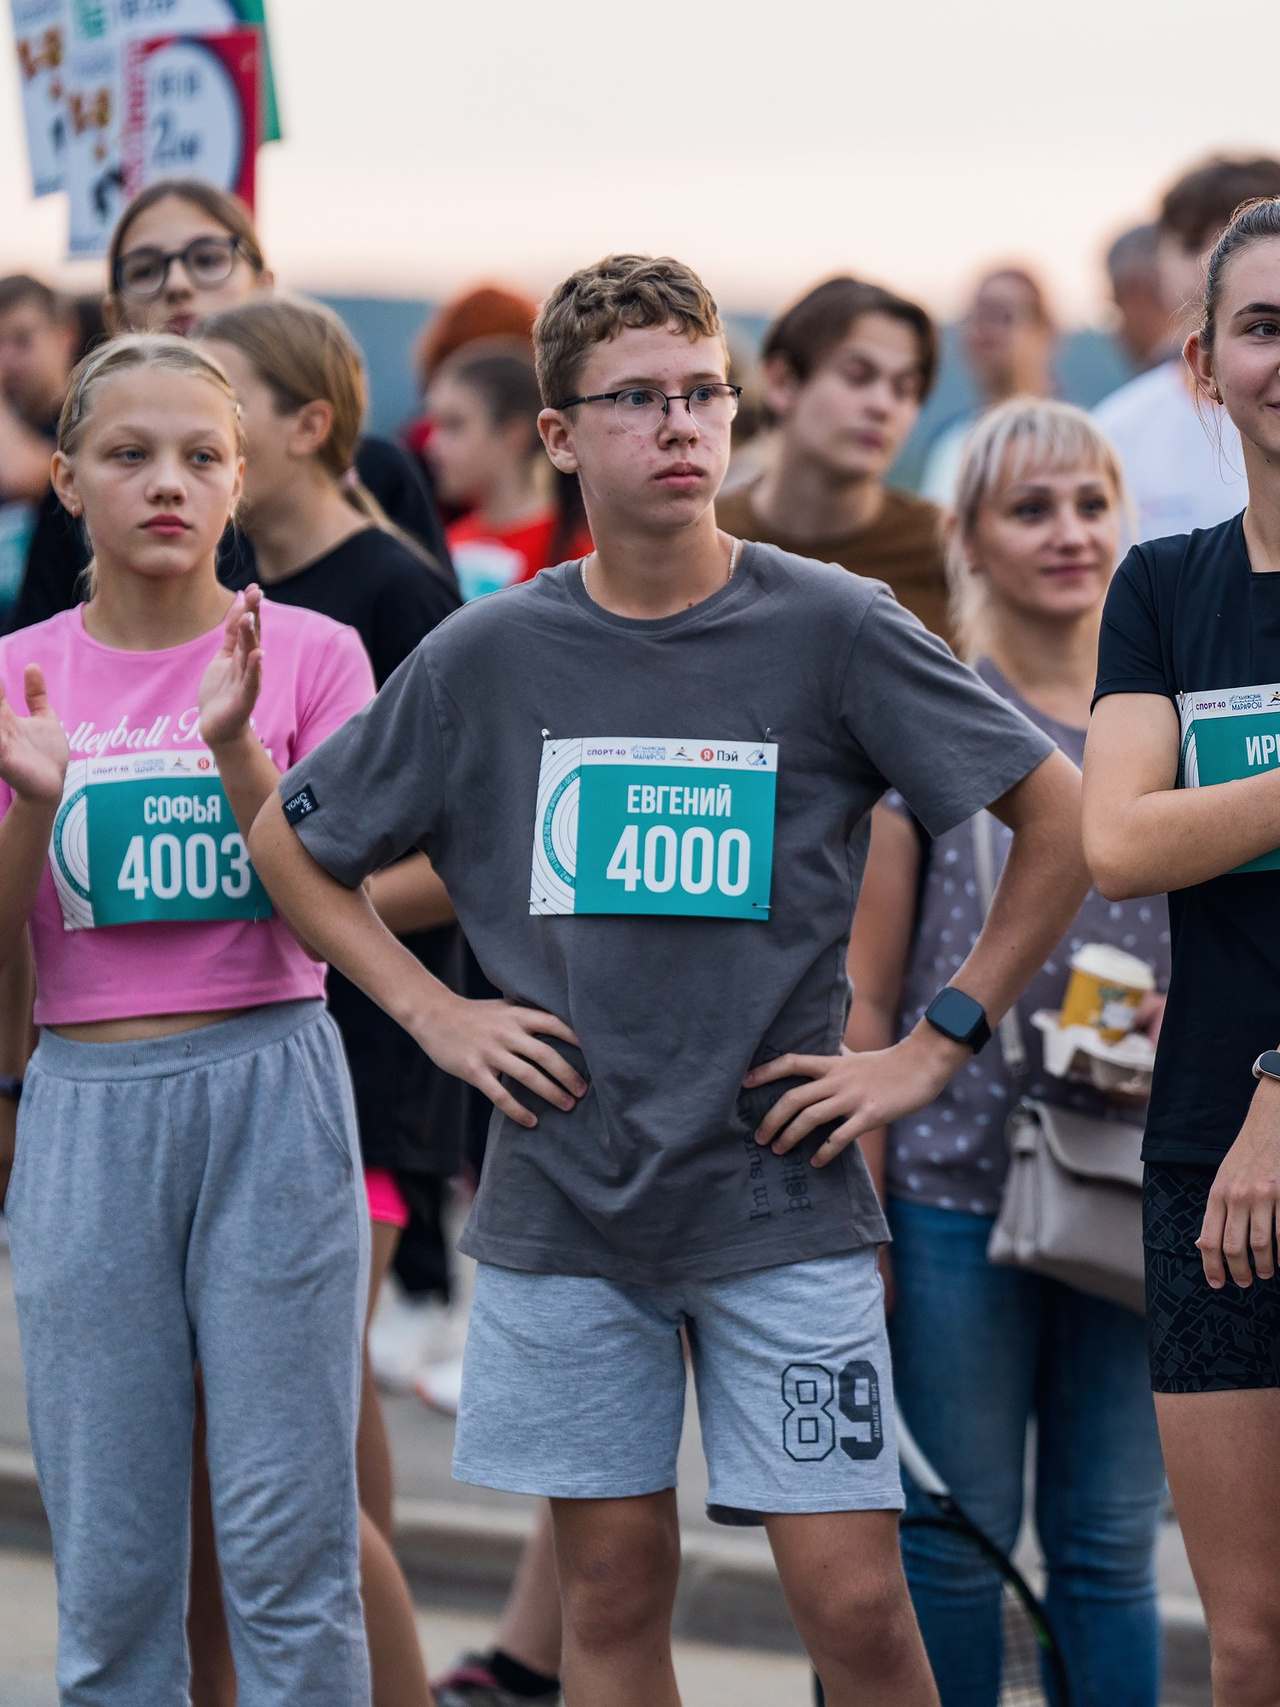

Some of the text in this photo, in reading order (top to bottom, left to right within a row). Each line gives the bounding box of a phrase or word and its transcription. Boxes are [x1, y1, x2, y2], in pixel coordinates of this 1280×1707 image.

[1195, 700, 1226, 711] СПОРТ 40
[1231, 700, 1263, 711] МАРАФОН
[61, 715, 170, 758] lleyball
[586, 748, 626, 756] СПОРТ 40
[716, 750, 739, 762] Пэй
[144, 794, 221, 825] СОФЬЯ
[285, 796, 301, 811] YOU
[627, 783, 732, 817] ЕВГЕНИЙ
[117, 832, 251, 900] 4003
[606, 824, 751, 897] 4000
[780, 1151, 812, 1214] bette
[781, 1360, 884, 1462] 89
